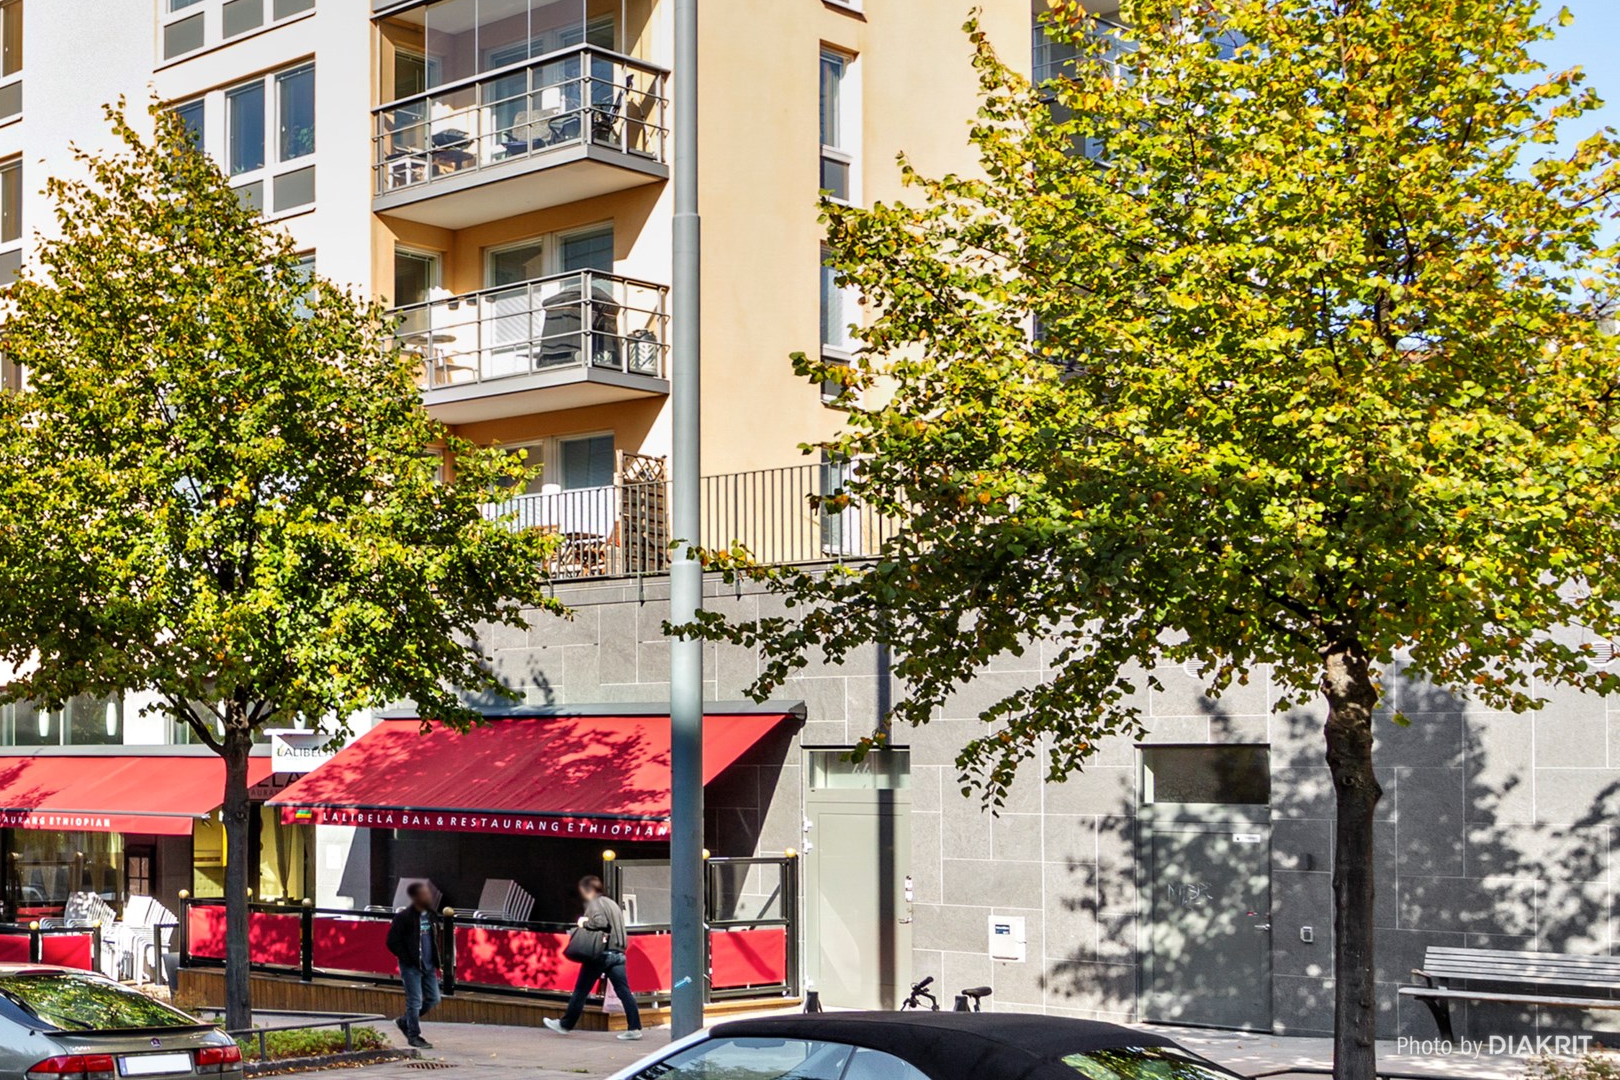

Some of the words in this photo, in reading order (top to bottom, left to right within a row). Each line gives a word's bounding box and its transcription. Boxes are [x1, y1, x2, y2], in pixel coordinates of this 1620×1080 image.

[49, 816, 111, 828] ETHIOPIAN
[323, 812, 393, 824] LALIBELA
[402, 815, 430, 825] BAR
[450, 817, 559, 832] RESTAURANG
[567, 822, 668, 836] ETHIOPIAN
